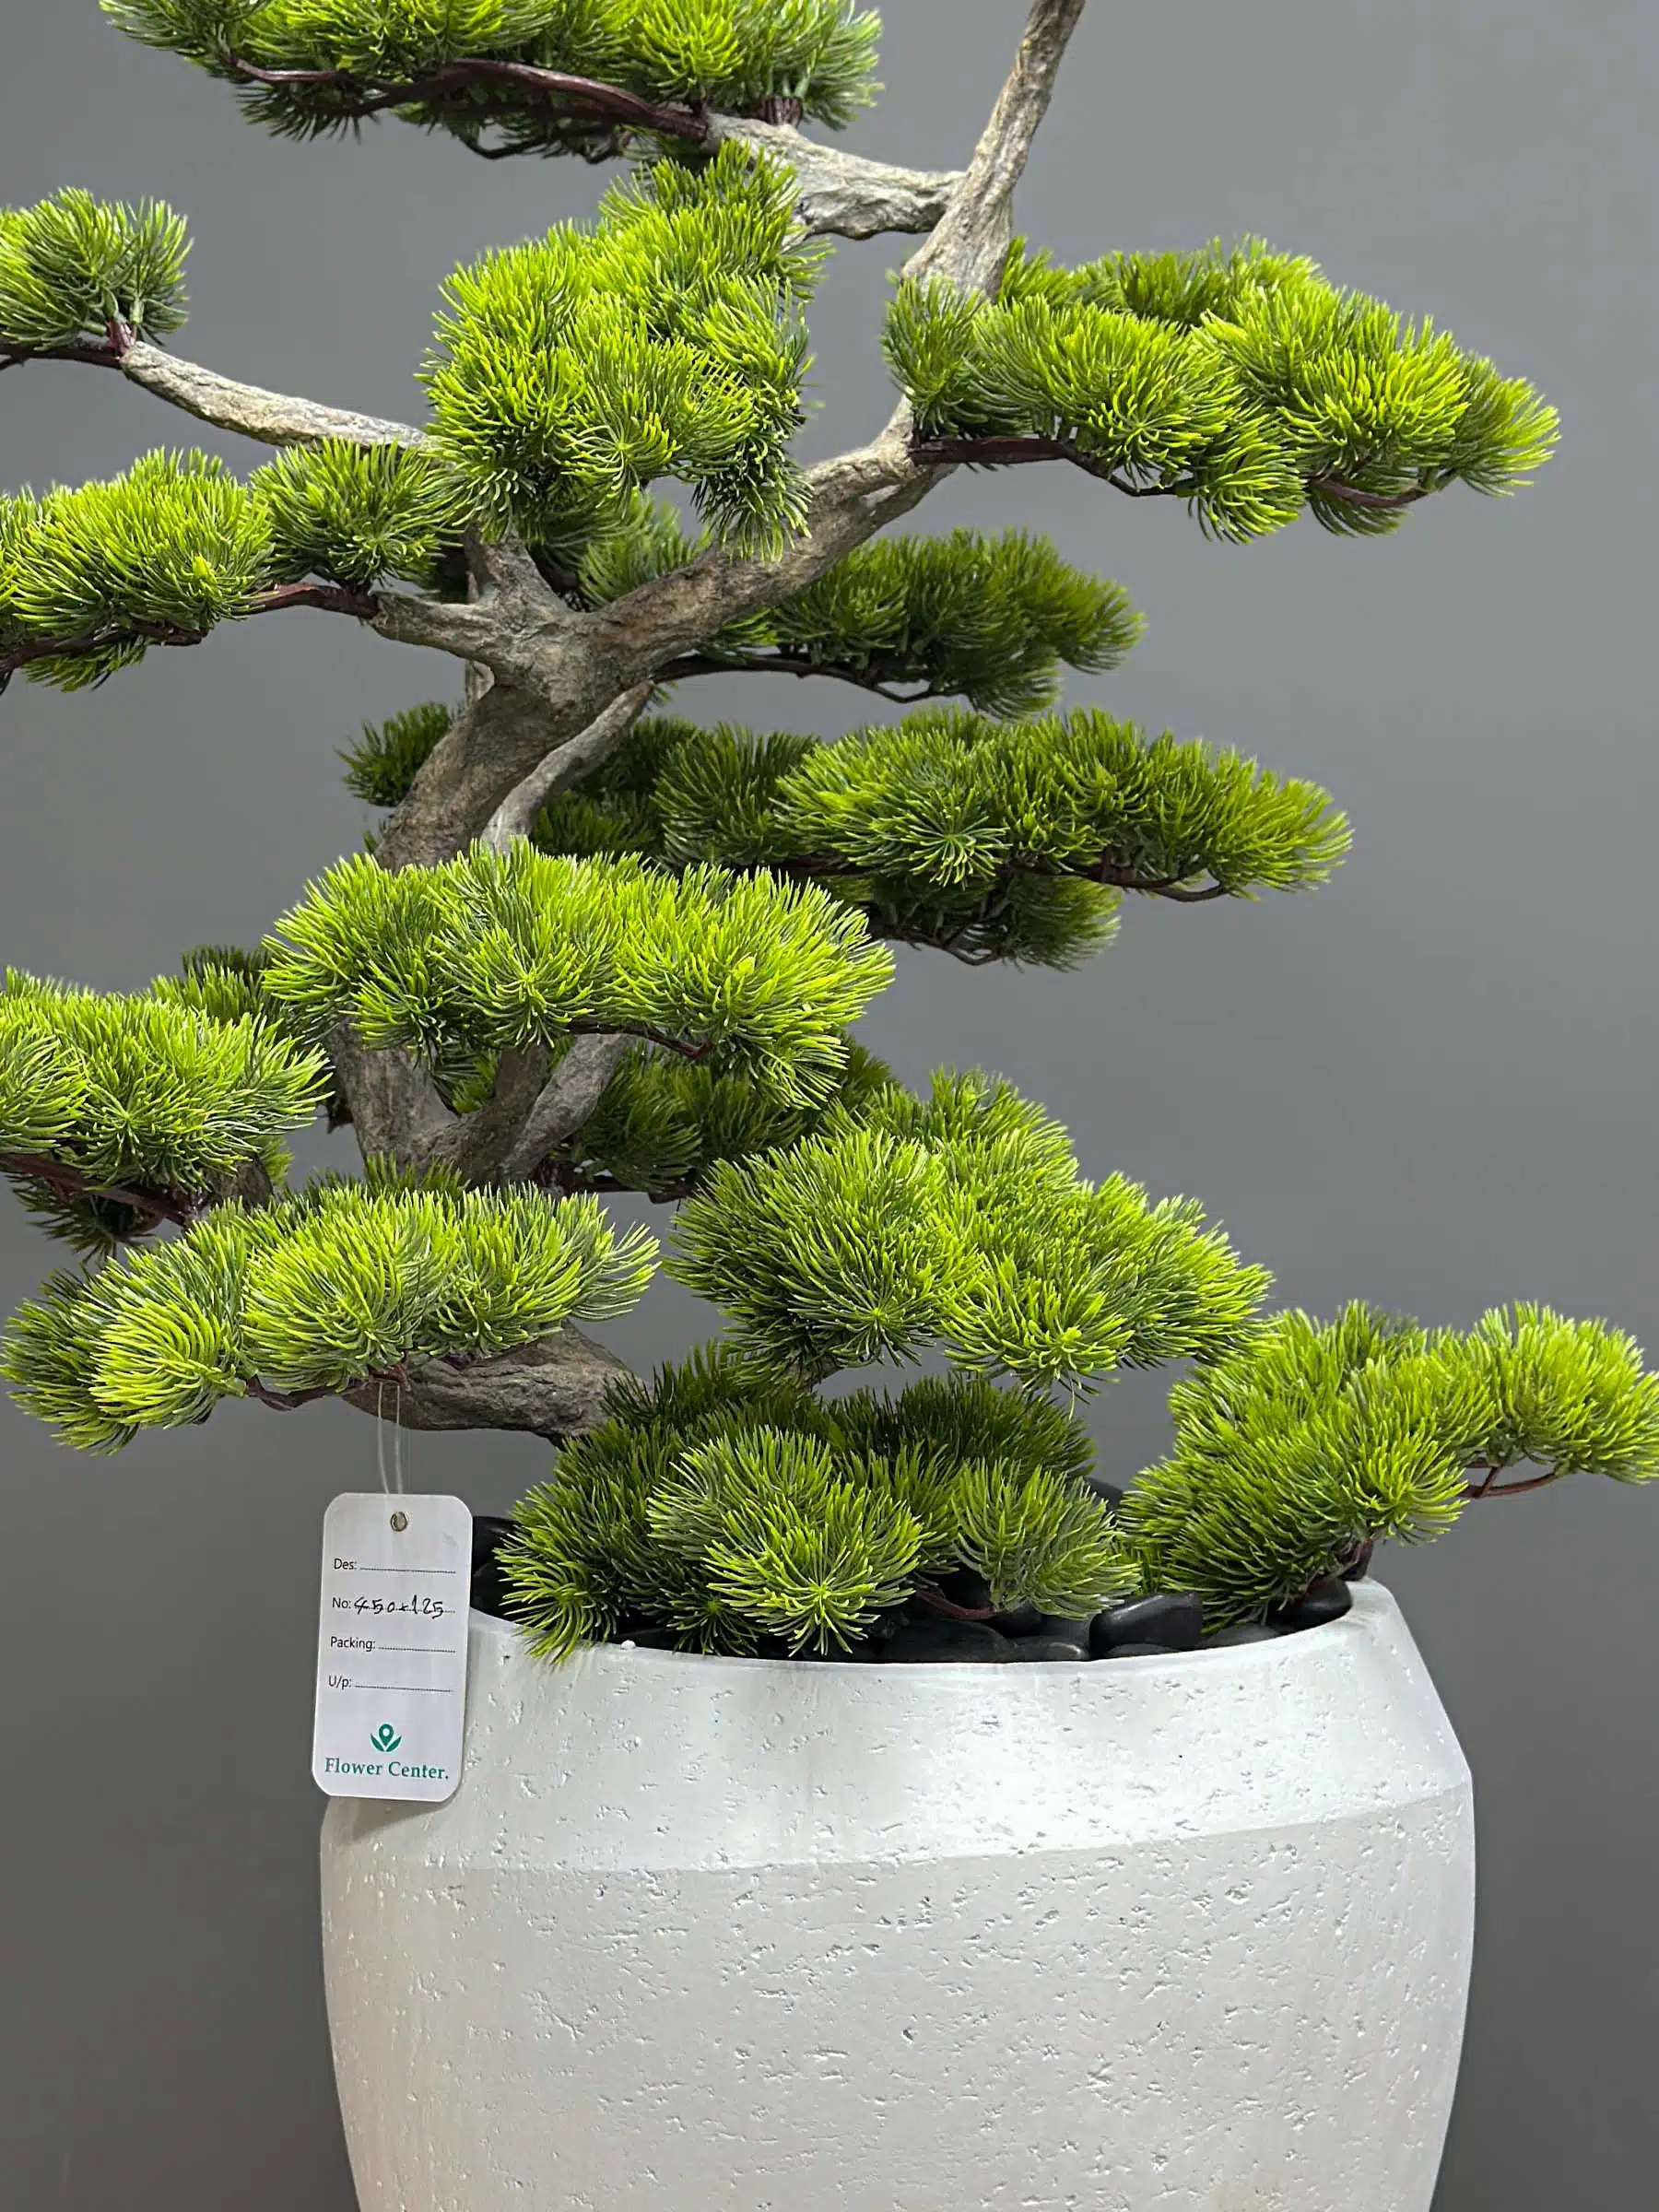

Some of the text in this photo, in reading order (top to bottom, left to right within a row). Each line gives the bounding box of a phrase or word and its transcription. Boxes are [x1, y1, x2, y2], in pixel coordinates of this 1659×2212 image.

[334, 1558, 357, 1571] Des:
[332, 1596, 351, 1609] No:
[330, 1636, 376, 1653] Packing:
[328, 1676, 352, 1690] U/p:
[324, 1757, 382, 1776] Flower
